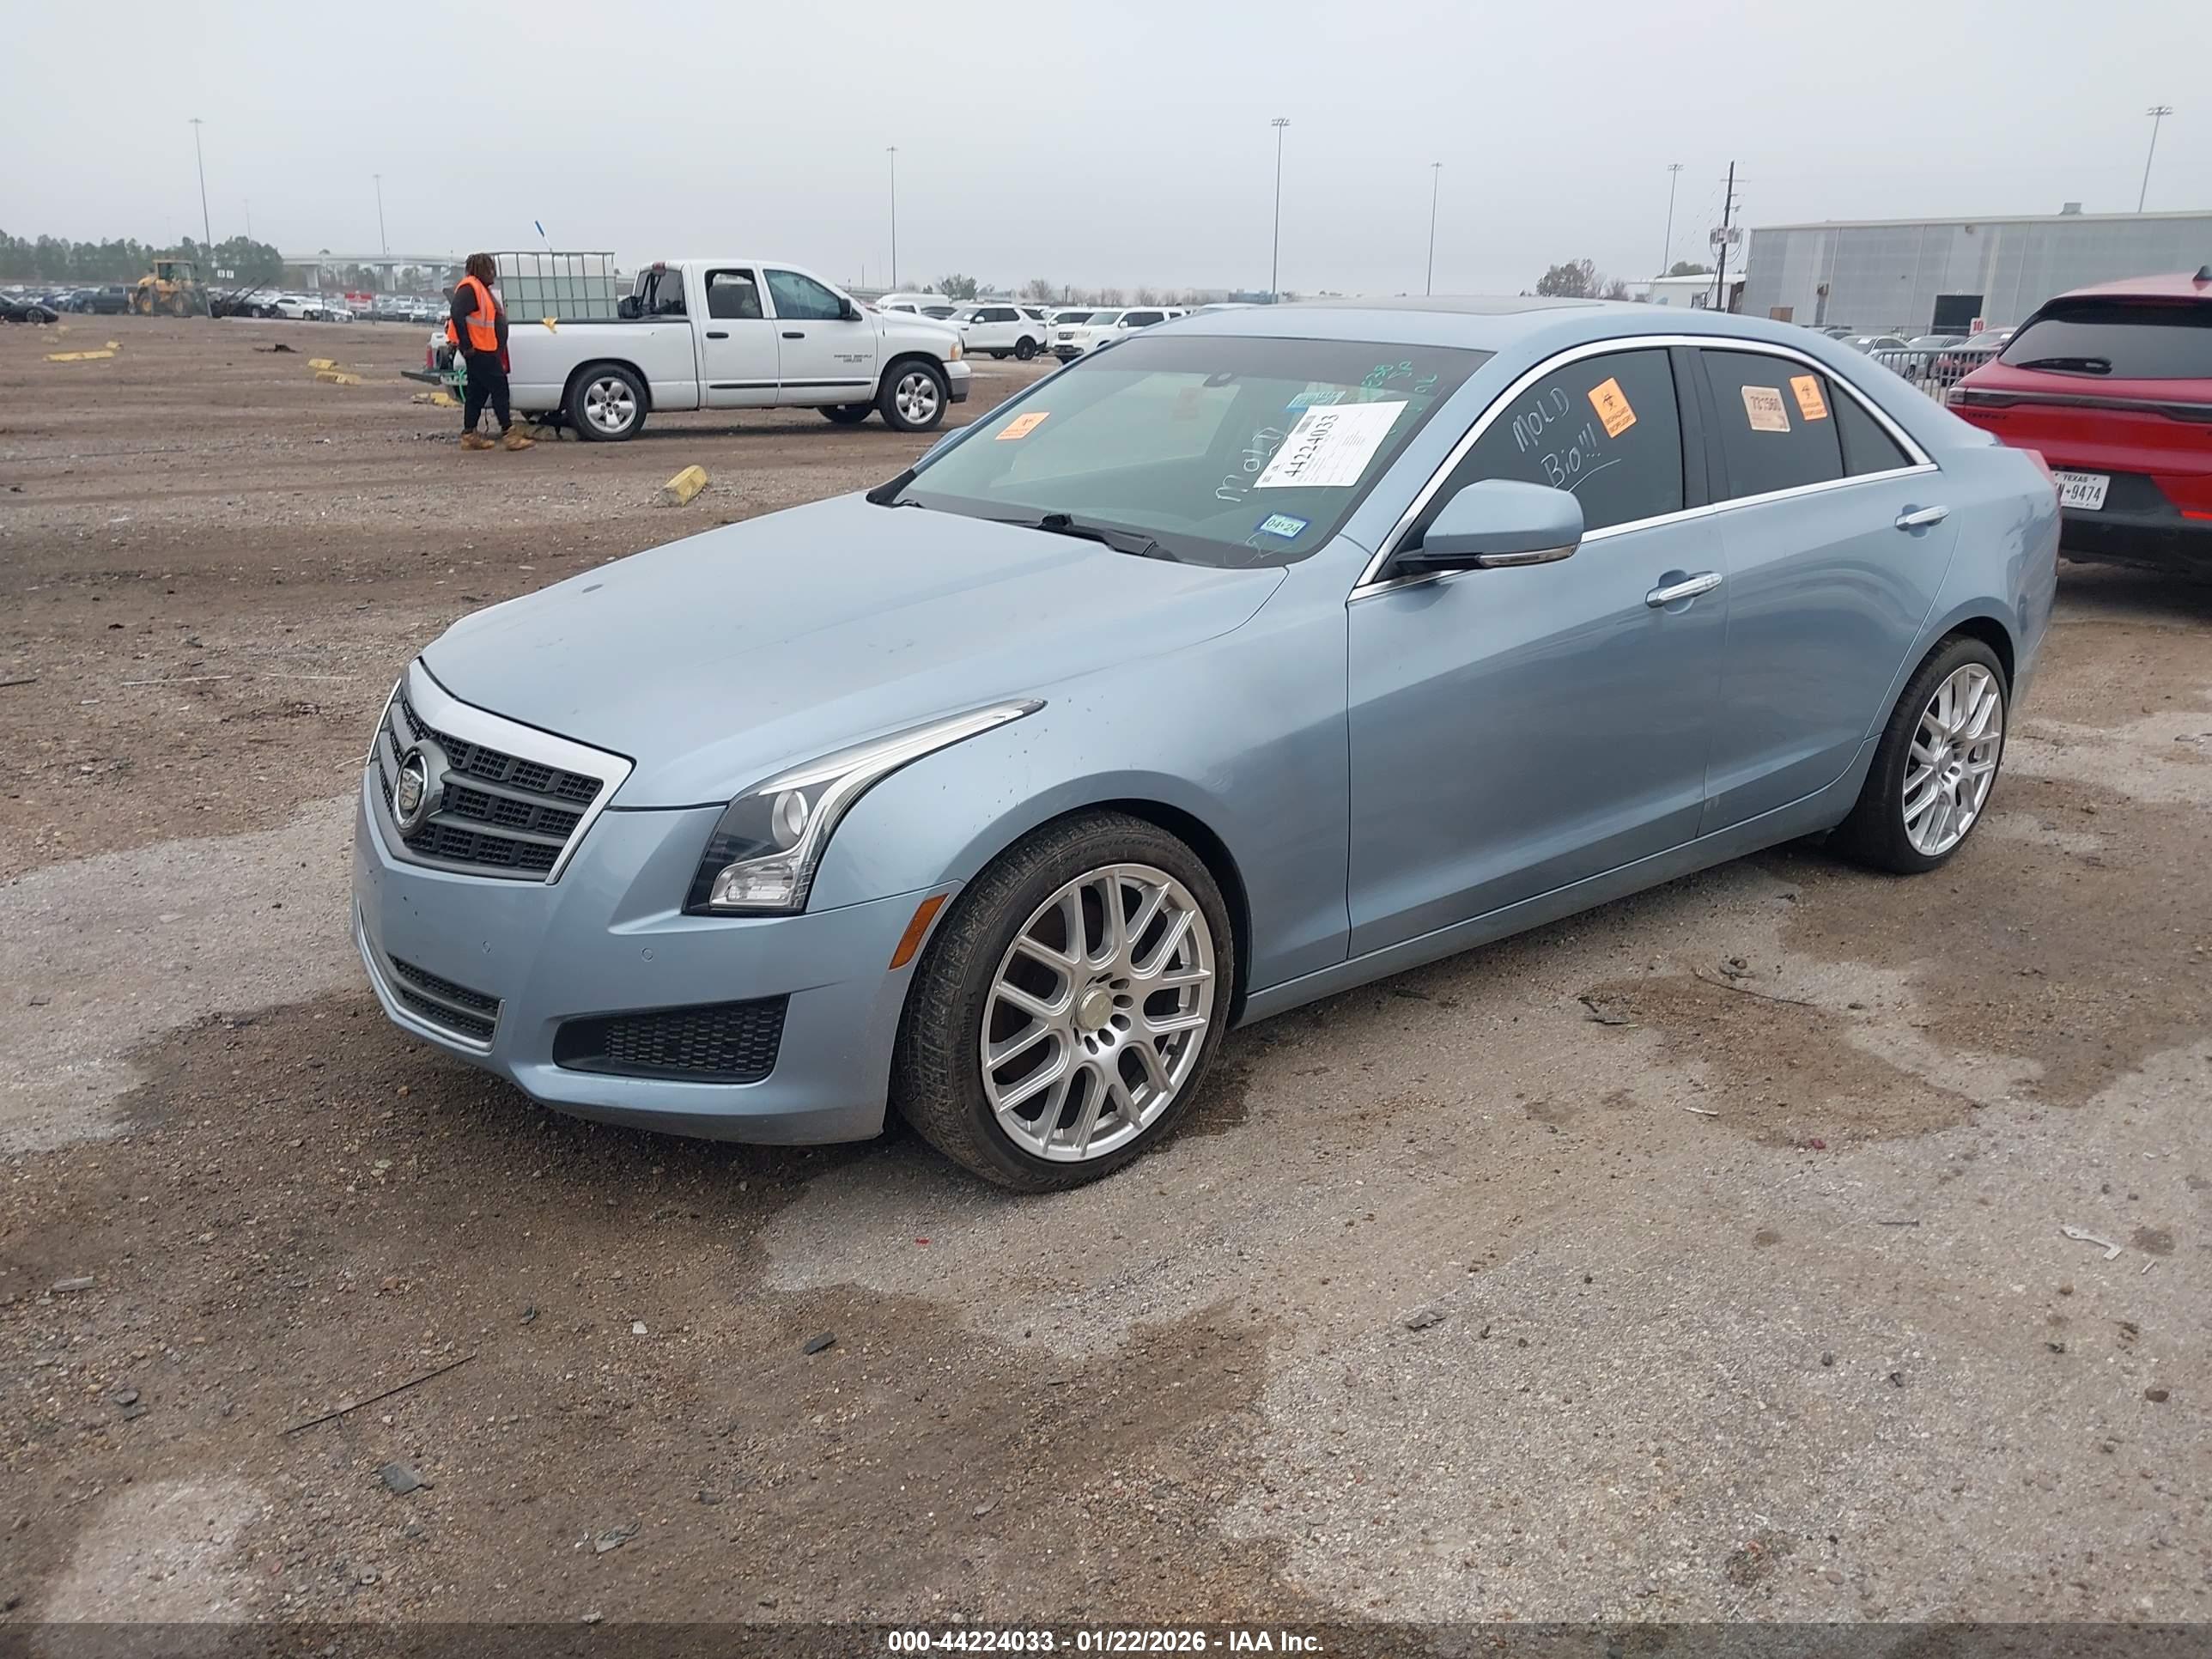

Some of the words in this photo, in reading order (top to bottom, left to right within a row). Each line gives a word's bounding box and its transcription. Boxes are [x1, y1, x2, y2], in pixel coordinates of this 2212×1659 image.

[1973, 320, 1984, 331] 10
[1285, 414, 1339, 477] 44224033
[2063, 474, 2088, 483] TEXAS
